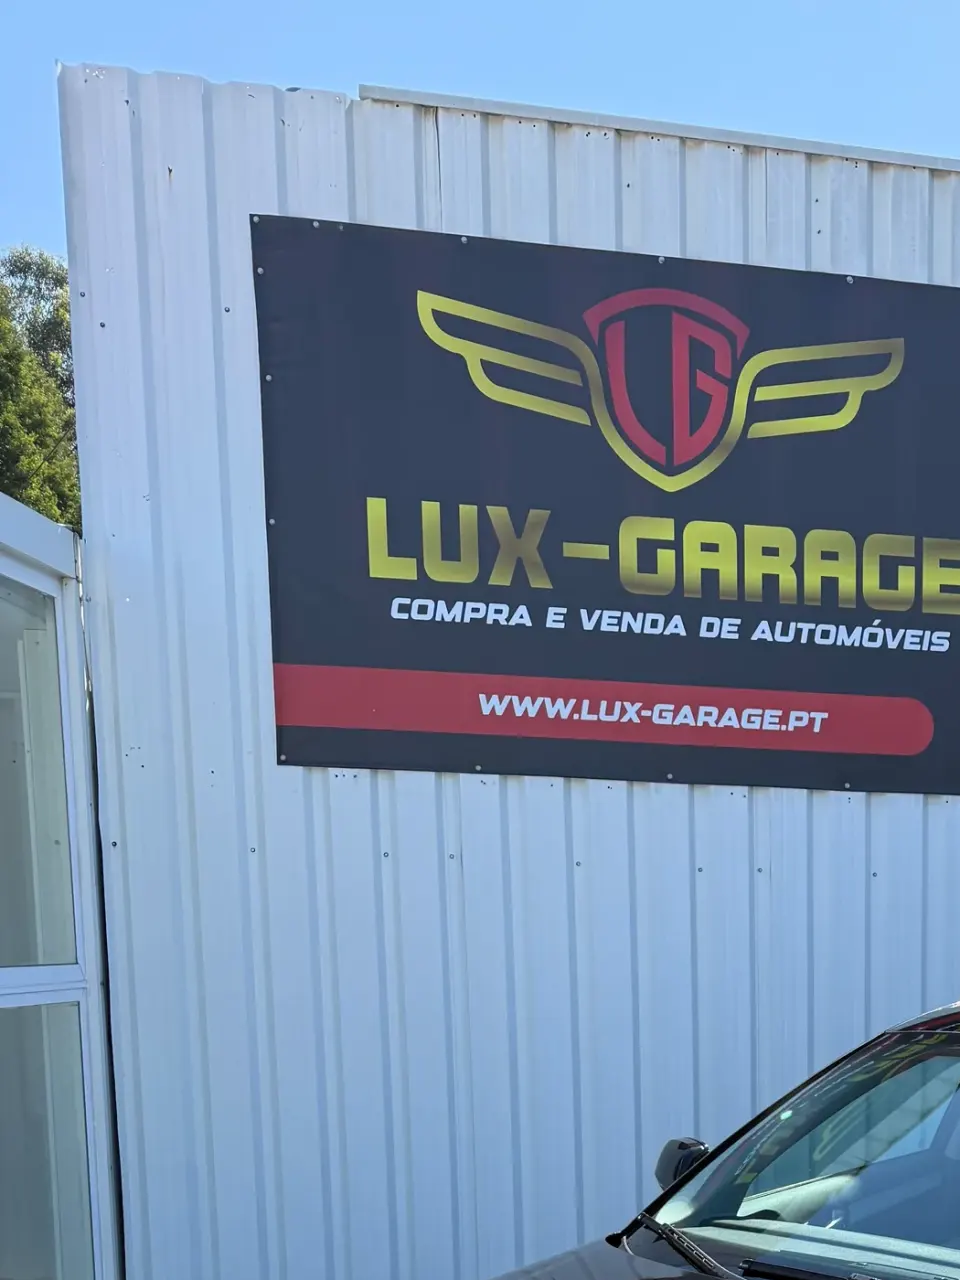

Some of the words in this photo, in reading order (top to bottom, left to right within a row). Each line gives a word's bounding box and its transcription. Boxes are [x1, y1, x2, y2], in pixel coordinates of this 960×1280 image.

[390, 597, 532, 628] COMPRA
[545, 607, 567, 628] E
[579, 608, 687, 636] VENDA
[699, 617, 740, 640] DE
[751, 619, 952, 652] AUTOMÓVEIS
[478, 692, 829, 733] WWW.LUX-GARAGE.PT
